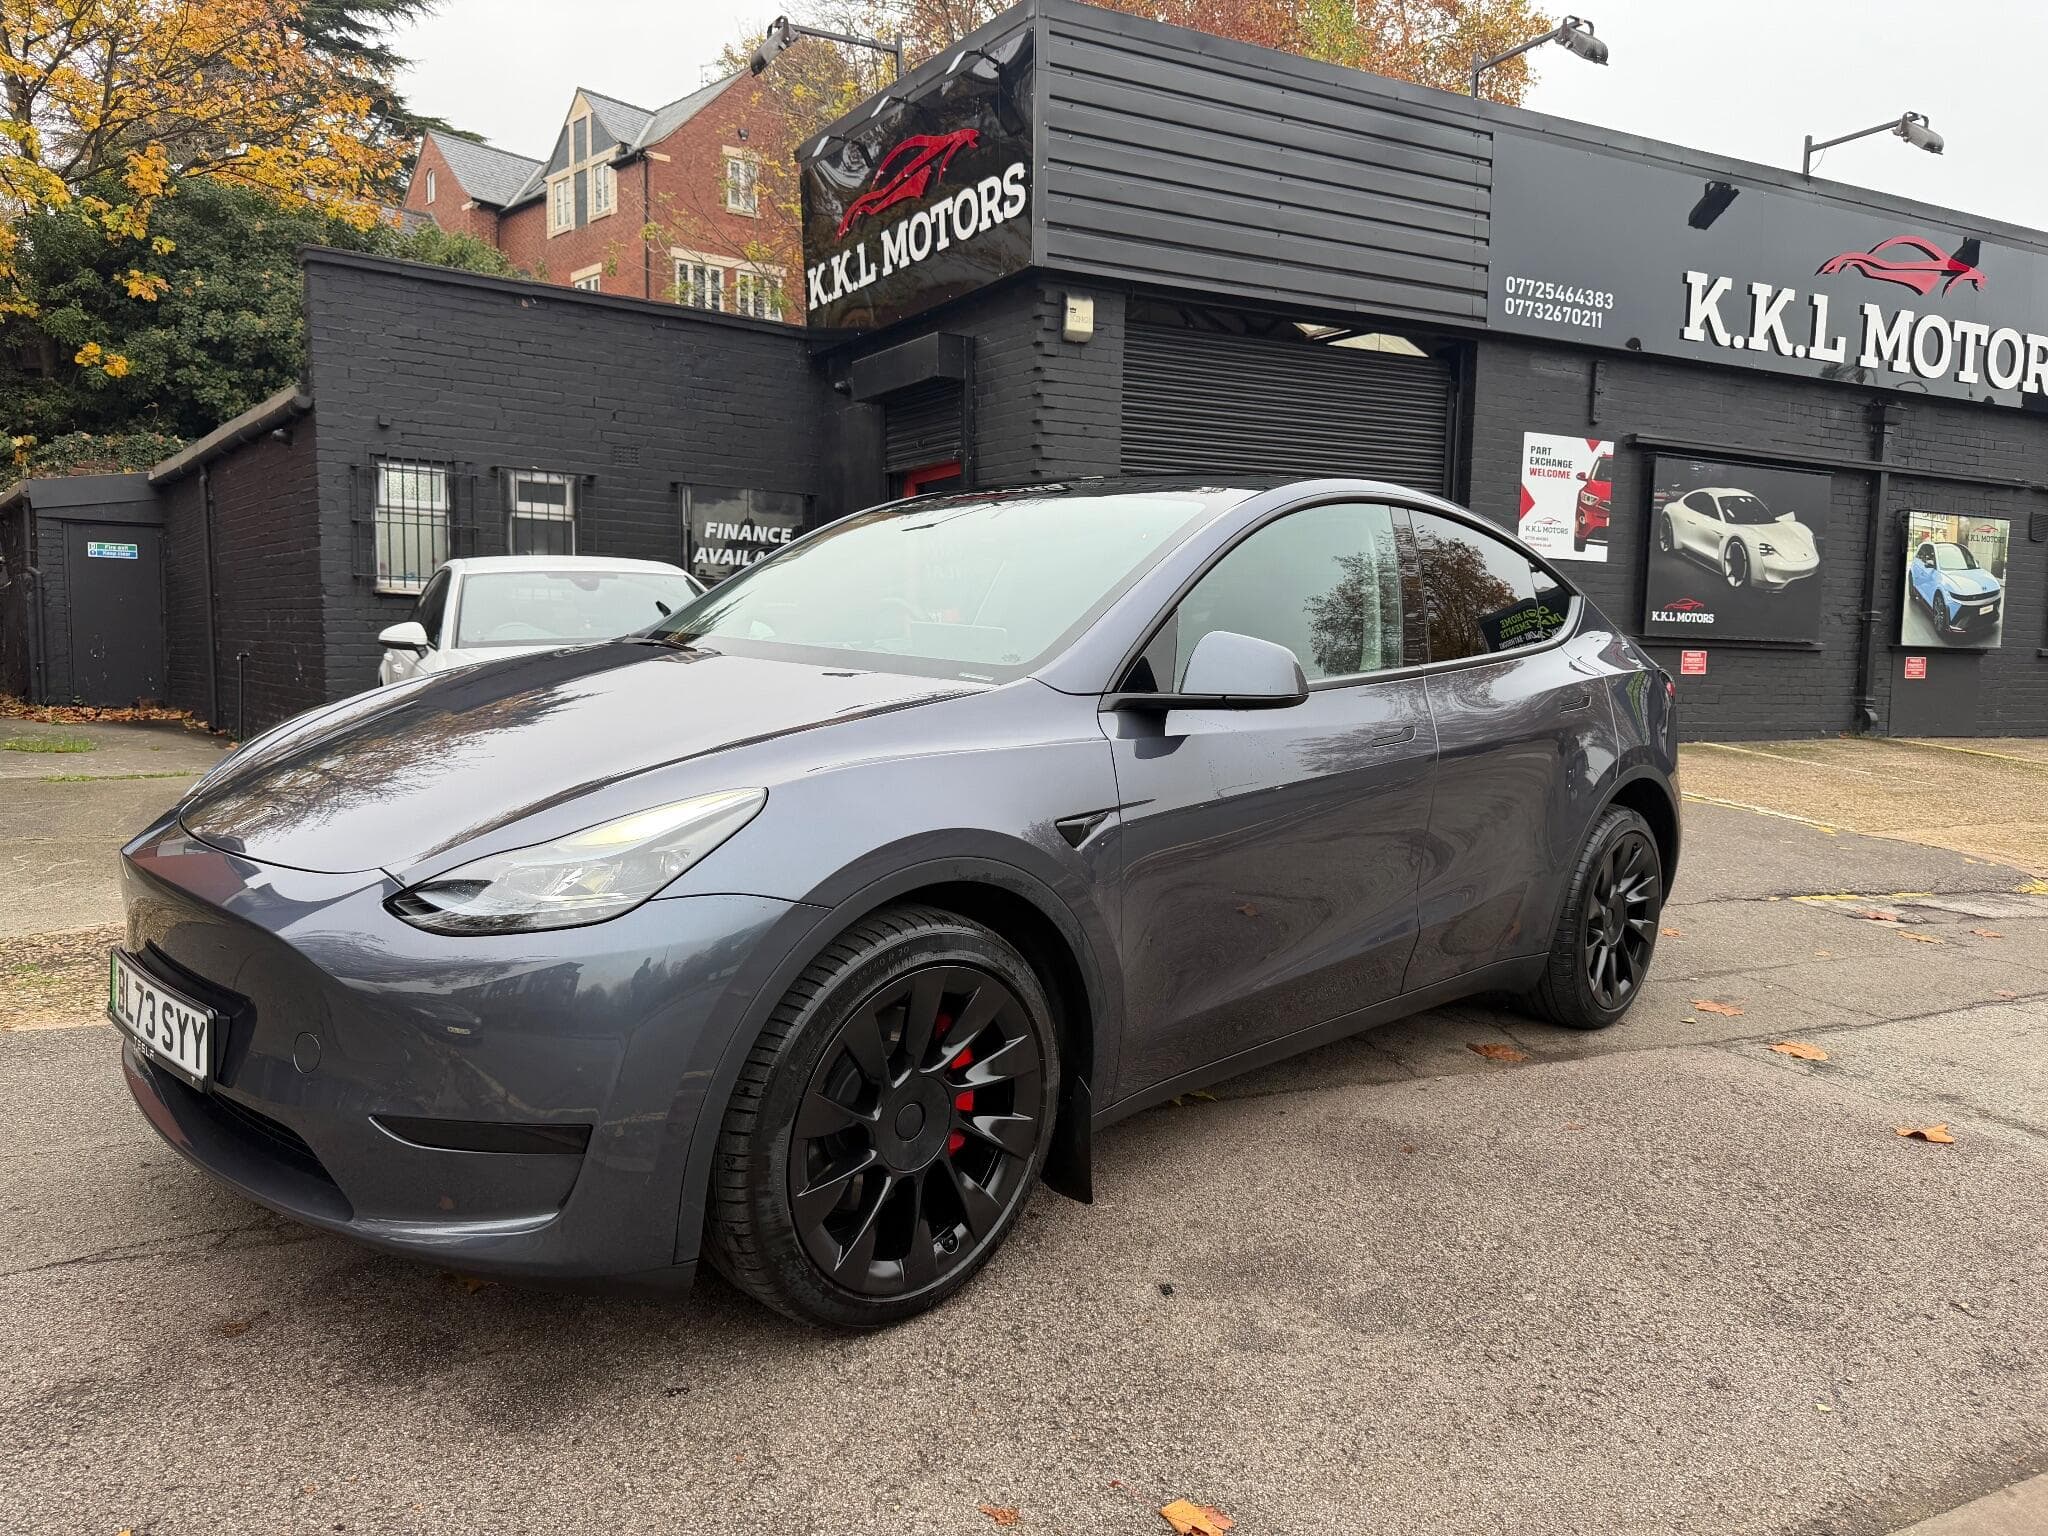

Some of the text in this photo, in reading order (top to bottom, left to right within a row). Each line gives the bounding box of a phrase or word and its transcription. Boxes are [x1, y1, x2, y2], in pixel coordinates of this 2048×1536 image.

[807, 162, 1026, 311] K.K.L MOTORS
[1506, 276, 1614, 309] 07725464383
[1505, 297, 1603, 328] 07732670211
[1683, 270, 1846, 364] K.K.L
[1530, 445, 1552, 456] PART
[1529, 457, 1573, 469] EXCHANGE
[1529, 467, 1571, 479] WELCOME
[704, 522, 793, 544] FINANCE
[1542, 527, 1569, 535] MOTORS
[1676, 612, 1715, 624] MOTORS
[118, 965, 206, 1070] BL73 SYY
